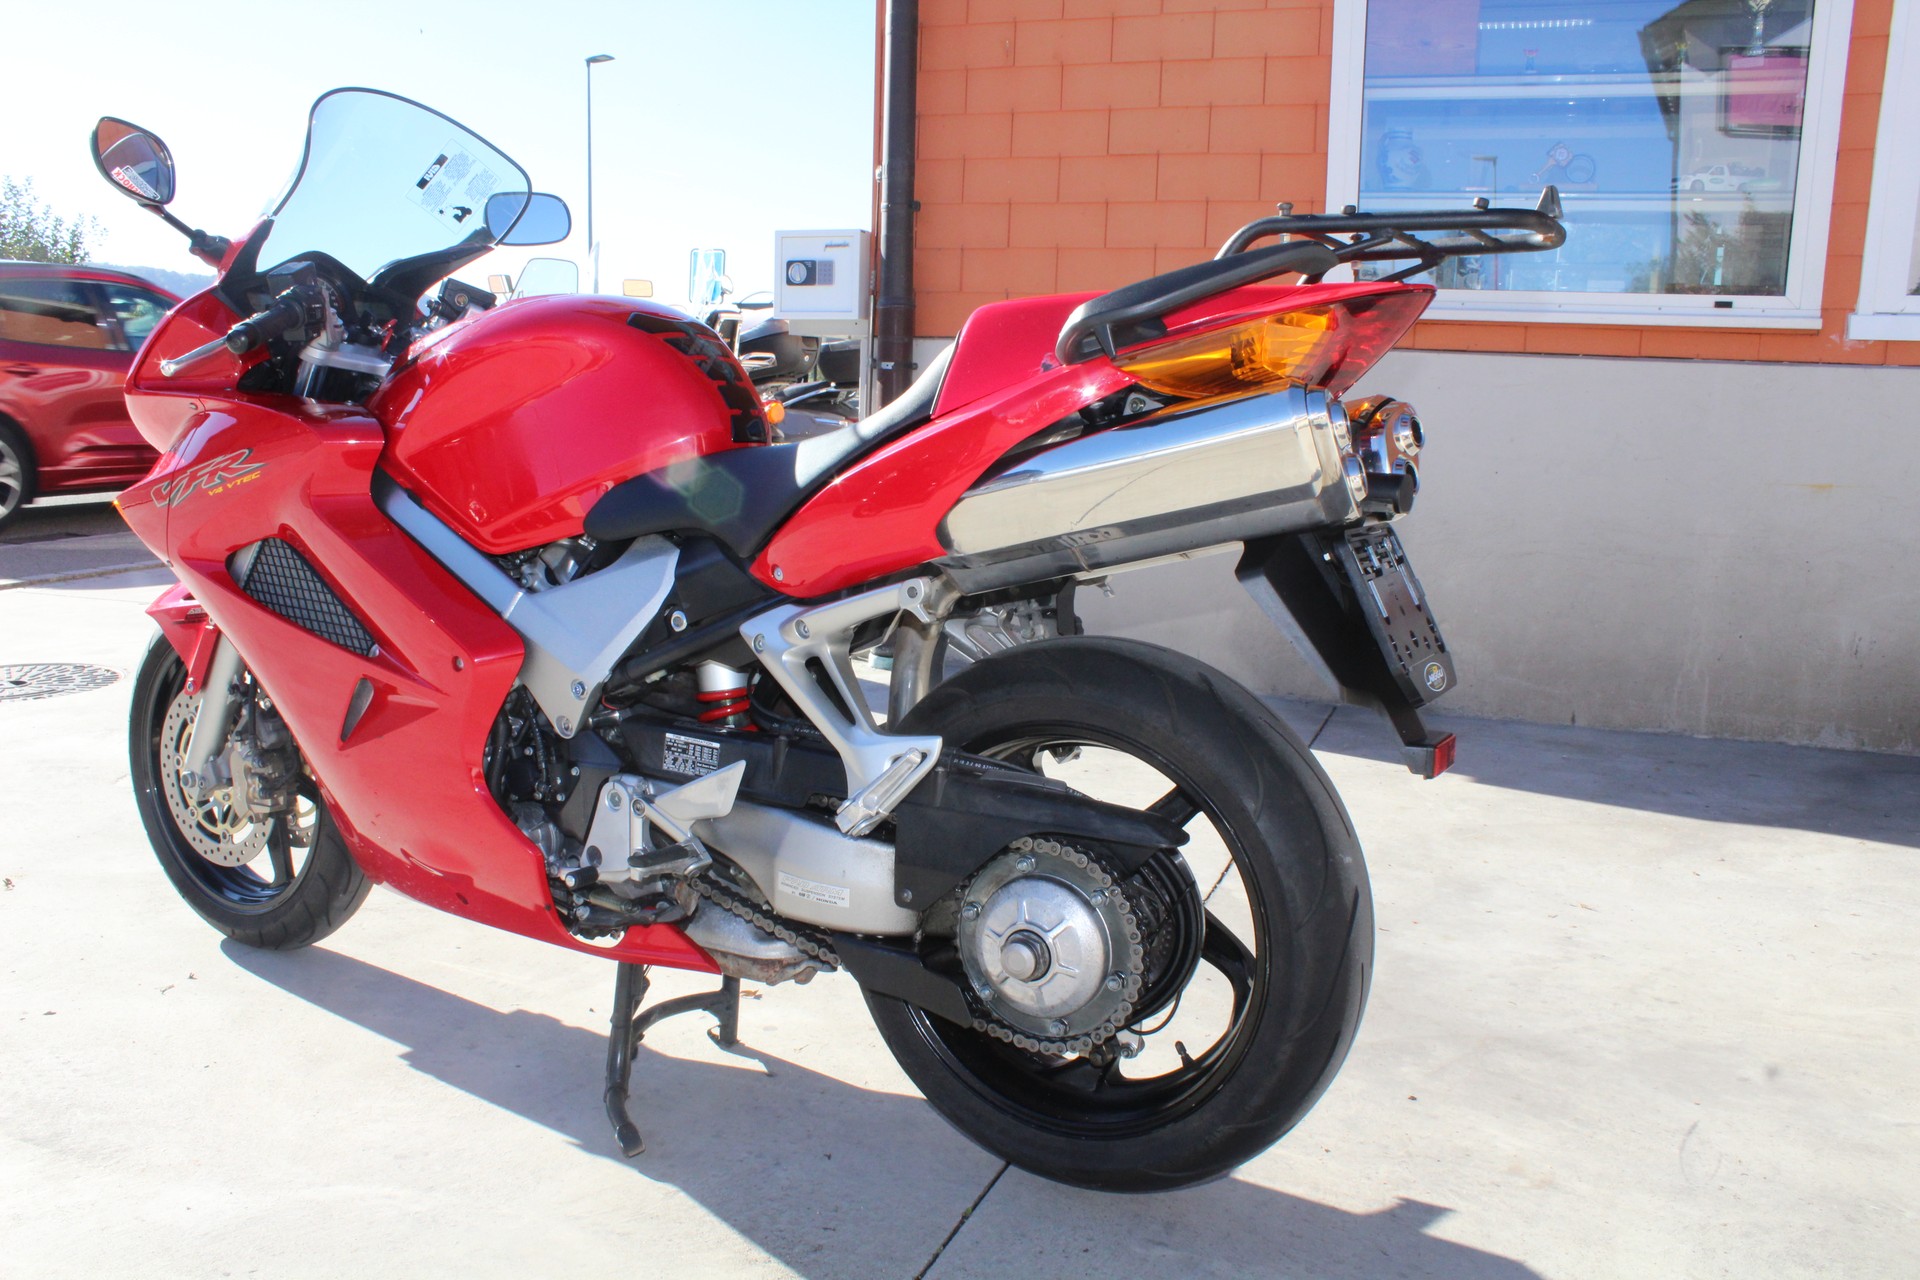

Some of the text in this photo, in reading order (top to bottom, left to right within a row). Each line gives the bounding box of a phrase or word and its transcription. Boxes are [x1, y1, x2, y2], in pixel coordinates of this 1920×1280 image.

[151, 448, 269, 508] VFR
[227, 470, 261, 488] VTEC
[801, 888, 826, 897] SUSPENSION
[816, 897, 838, 905] HONDA
